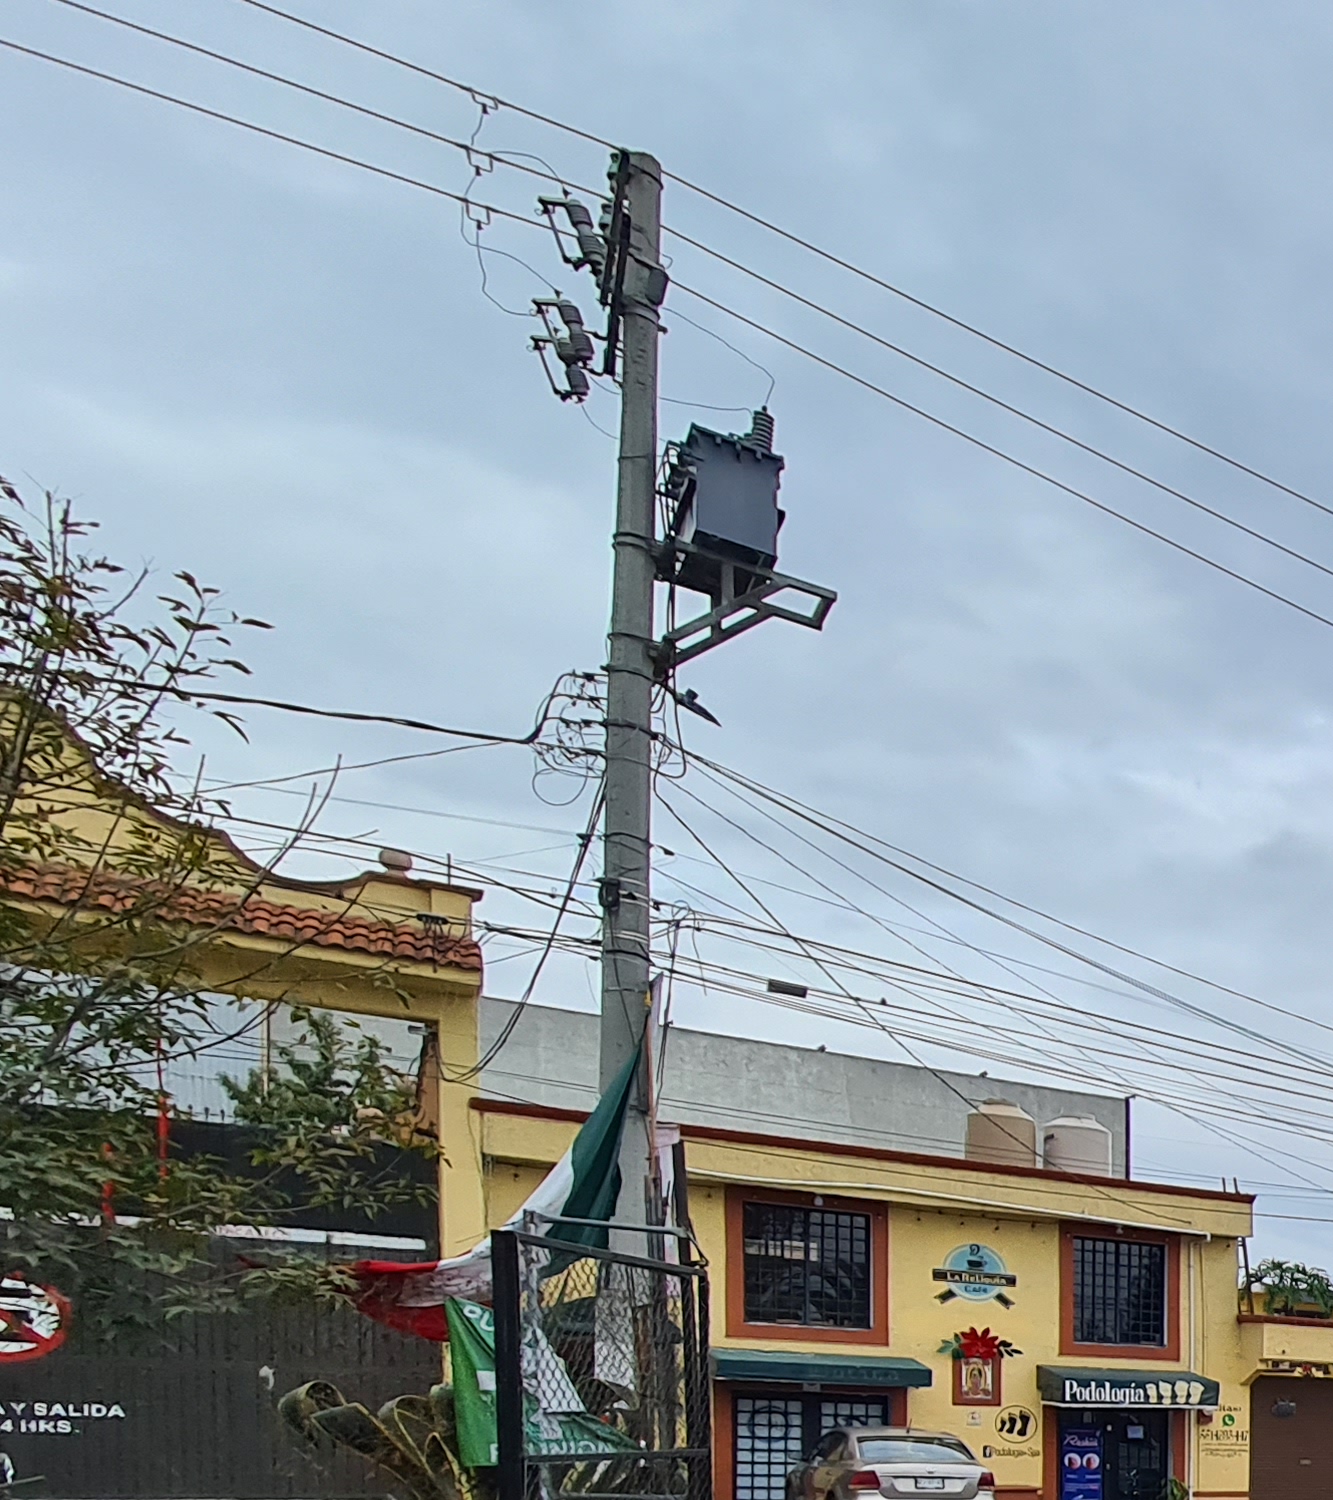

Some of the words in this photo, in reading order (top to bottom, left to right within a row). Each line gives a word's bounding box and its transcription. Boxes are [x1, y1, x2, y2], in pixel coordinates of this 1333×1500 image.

[1064, 1379, 1145, 1404] Podología
[9, 1402, 27, 1416] Y
[33, 1402, 126, 1417] SALIDA
